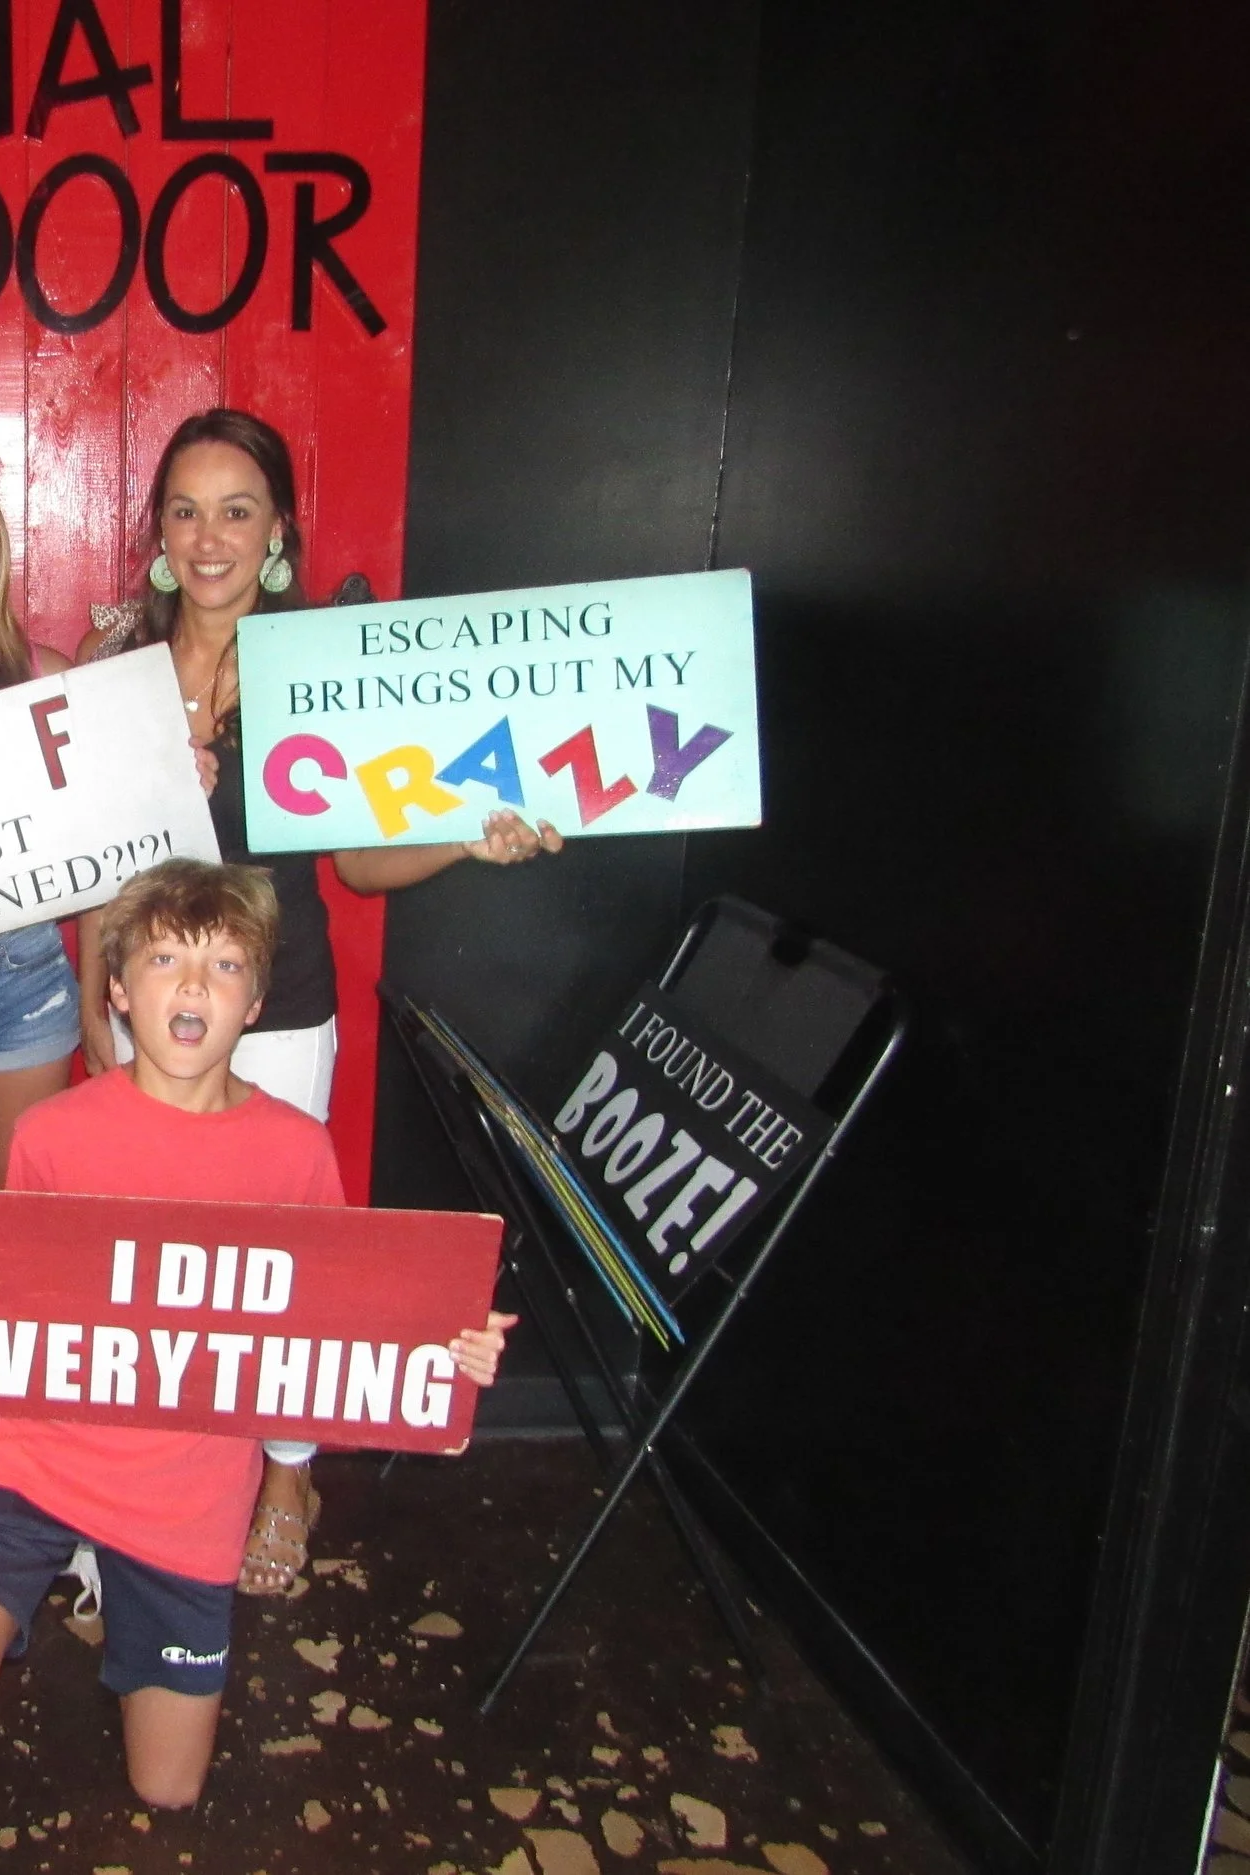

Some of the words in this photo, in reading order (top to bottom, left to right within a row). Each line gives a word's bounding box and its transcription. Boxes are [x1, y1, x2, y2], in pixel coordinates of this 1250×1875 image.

[358, 602, 613, 656] ESCAPING
[288, 668, 472, 716] BRINGS
[487, 659, 594, 699] OUT
[615, 650, 697, 691] MY
[263, 703, 734, 839] CRAZY
[618, 1002, 646, 1037] I
[631, 1014, 735, 1112] FOUND
[553, 1051, 758, 1275] BOOZE!
[728, 1090, 803, 1170] THE
[109, 1239, 136, 1305] I
[156, 1242, 294, 1315] DID
